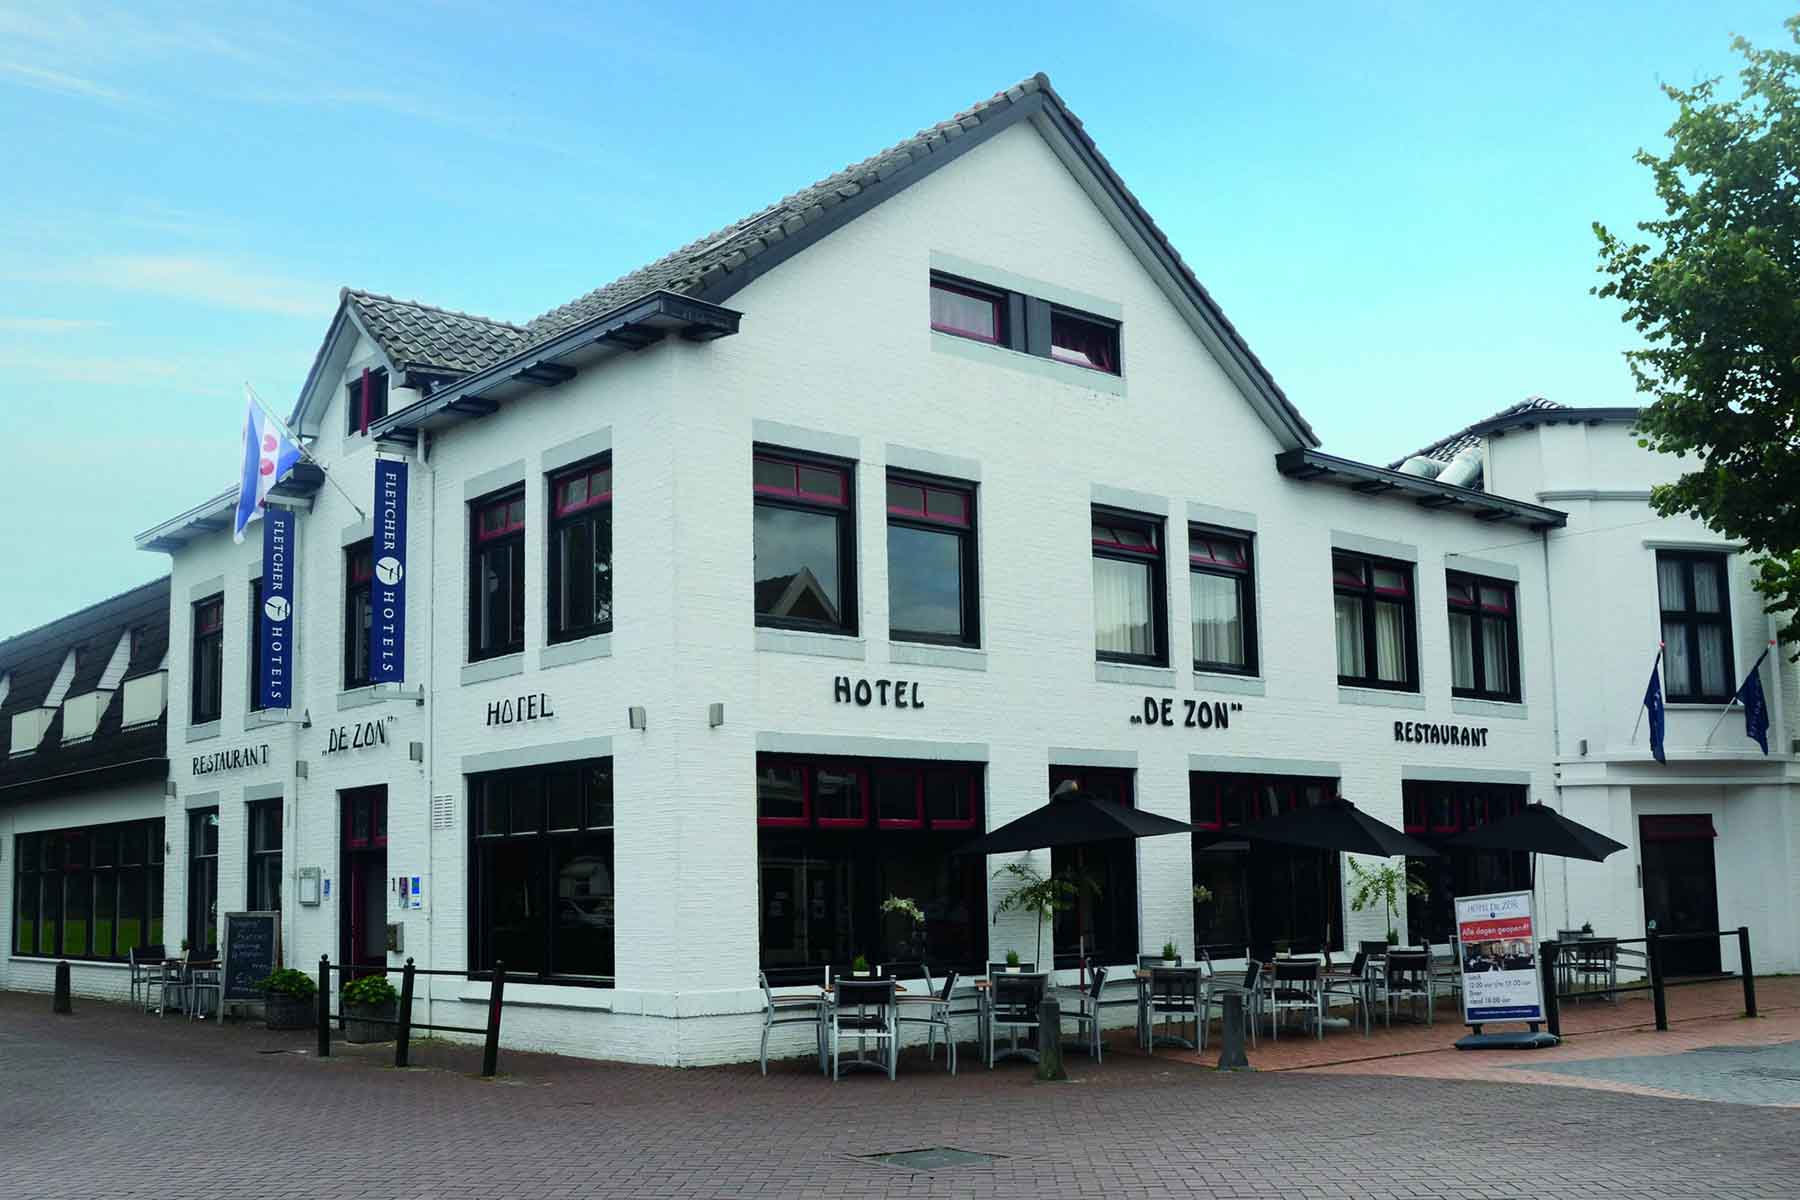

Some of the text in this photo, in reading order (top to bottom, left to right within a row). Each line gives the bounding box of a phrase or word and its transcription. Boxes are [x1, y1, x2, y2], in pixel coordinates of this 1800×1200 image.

[382, 472, 397, 672] FLETCHER HOTELS
[271, 520, 285, 699] FLETCHER HOTELS
[833, 675, 925, 709] HOTEL
[486, 692, 554, 727] HOTEL
[1394, 720, 1489, 748] RESTAURANT
[192, 744, 269, 776] RESTAURANT
